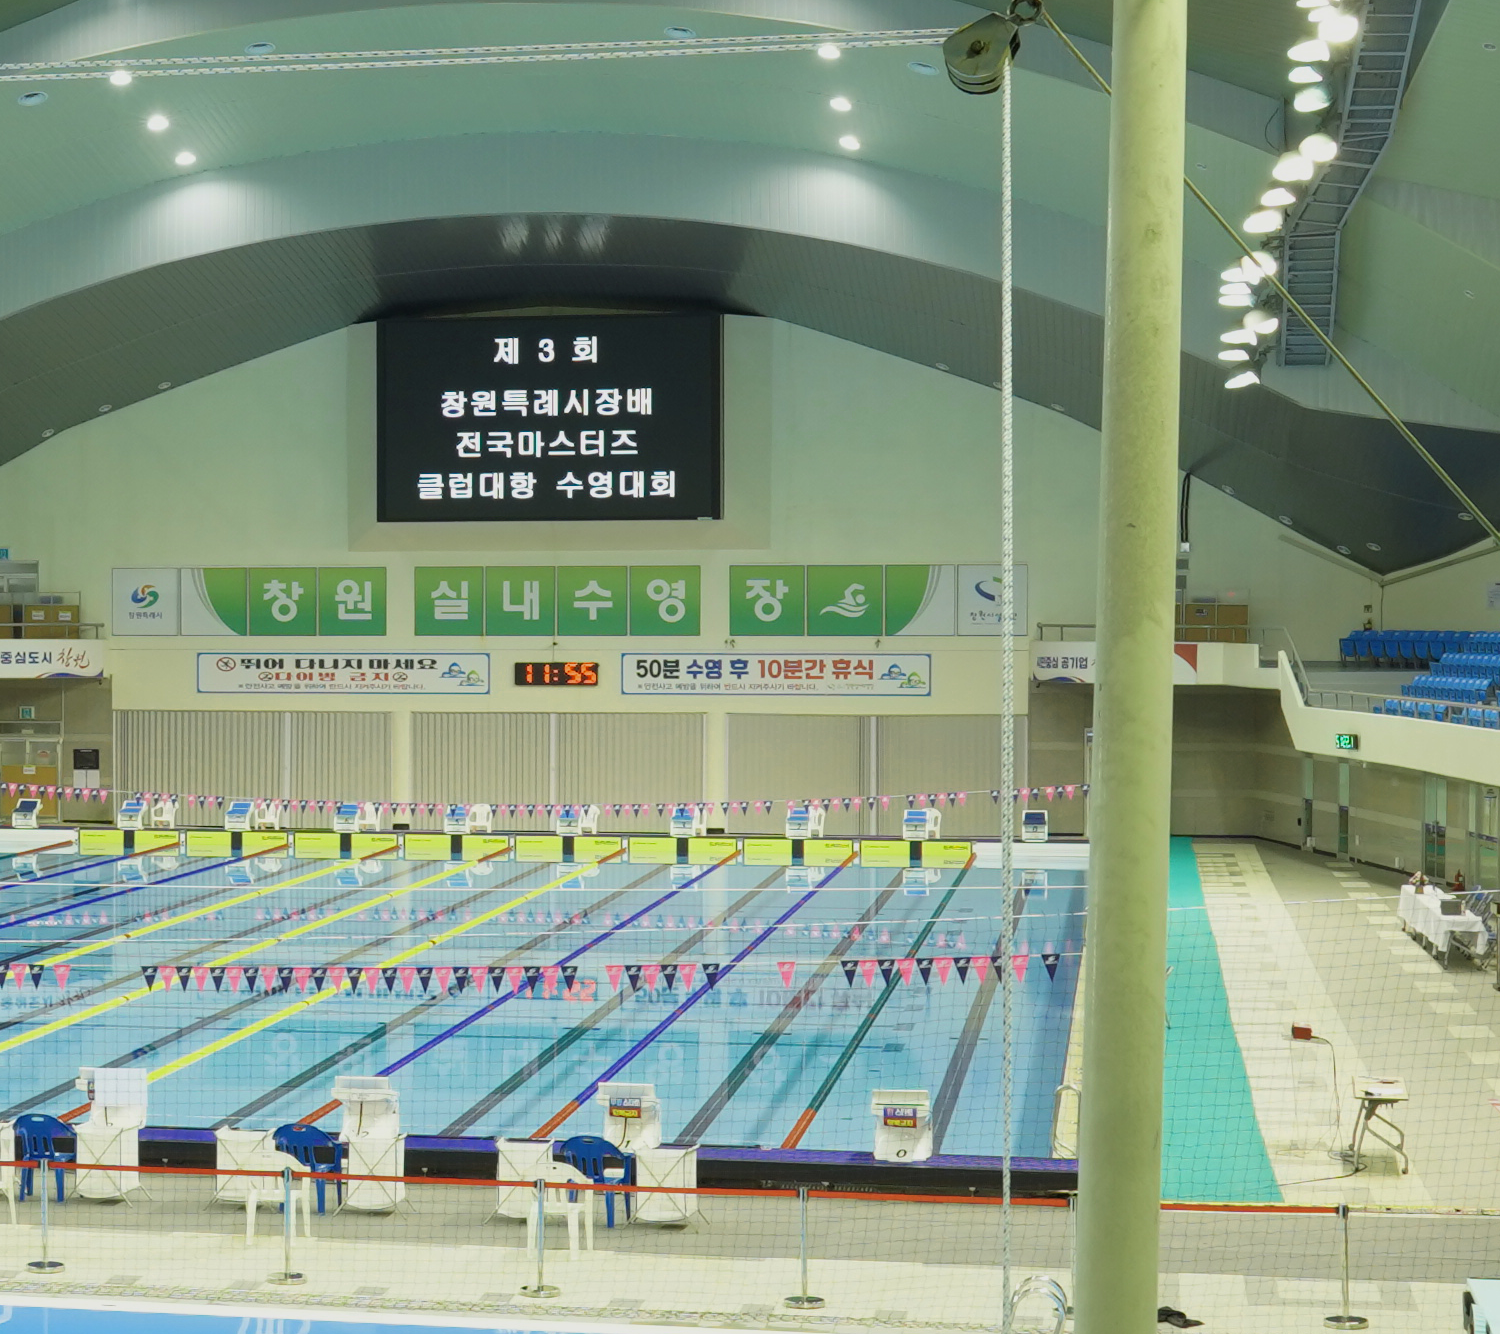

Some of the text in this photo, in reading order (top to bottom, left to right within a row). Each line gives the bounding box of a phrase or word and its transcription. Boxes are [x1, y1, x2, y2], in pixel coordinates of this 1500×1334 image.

[494, 336, 598, 365] 제 3 회
[440, 387, 652, 418] 창원특례시장배
[456, 429, 638, 458] 전국마스터즈
[417, 470, 676, 500] 클럽대항 수영대회
[263, 579, 372, 623] 창원
[0, 651, 52, 665] 중심도시
[295, 658, 361, 670] 다니지
[368, 658, 438, 670] 마세요
[1061, 656, 1088, 669] 공기업
[350, 672, 389, 681] 금지
[525, 663, 598, 685] 11:55
[636, 659, 874, 680] 50분 수영 후 10분간 휴식
